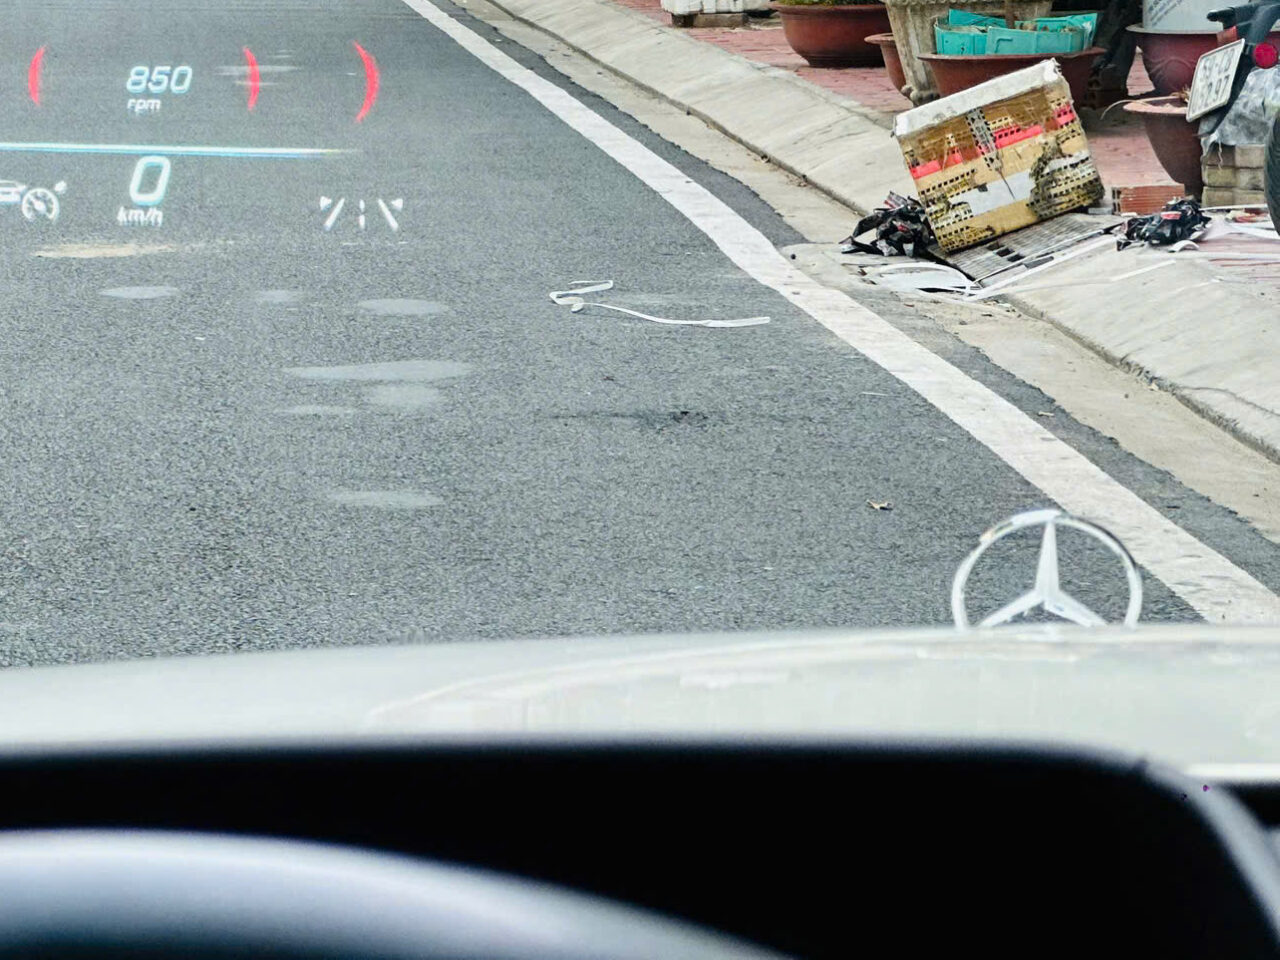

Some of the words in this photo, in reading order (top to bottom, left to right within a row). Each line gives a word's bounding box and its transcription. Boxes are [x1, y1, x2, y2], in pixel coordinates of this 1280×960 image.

[126, 65, 193, 94] 850
[127, 98, 162, 114] rpm
[129, 155, 172, 206] 0
[117, 206, 163, 226] km/h
